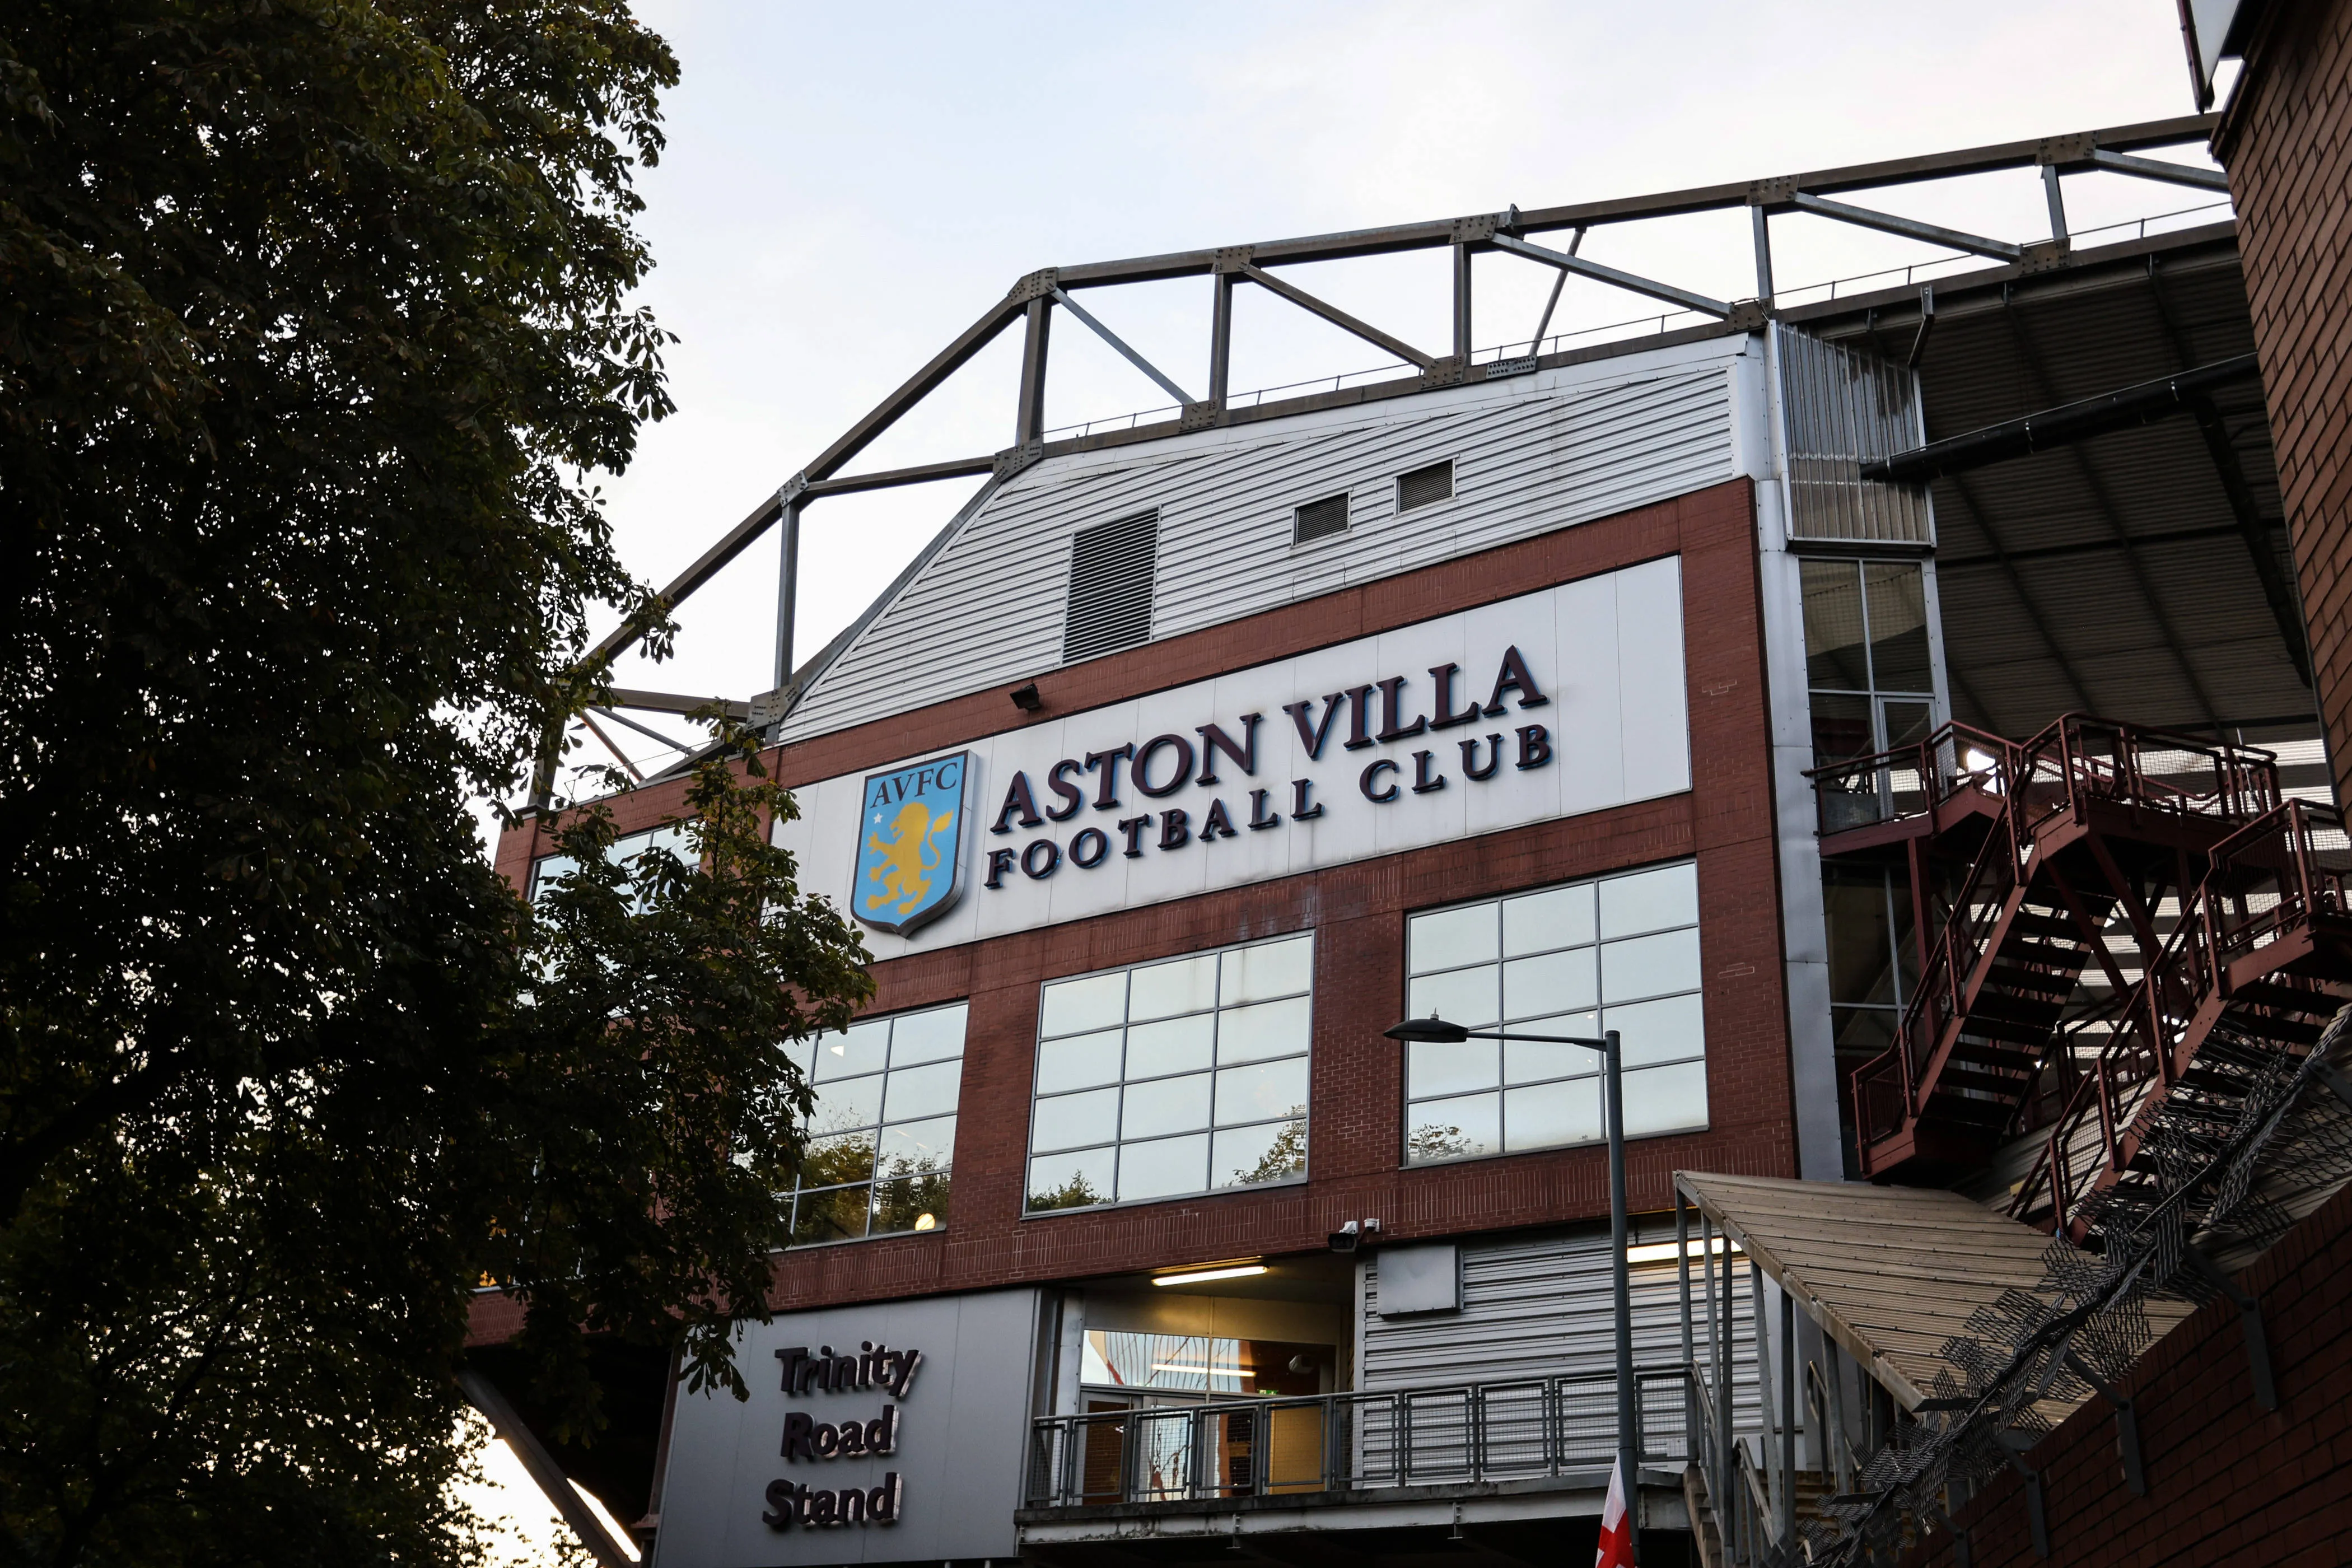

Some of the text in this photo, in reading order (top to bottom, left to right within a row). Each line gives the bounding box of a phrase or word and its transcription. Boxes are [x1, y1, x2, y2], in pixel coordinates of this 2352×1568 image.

[990, 644, 1550, 834] ASTON VILLA
[870, 762, 958, 809] AVFC
[983, 724, 1553, 889] FOOTBALL CLUB
[774, 1340, 922, 1396] Trinity
[780, 1404, 899, 1458] Road
[762, 1472, 902, 1526] Stand
